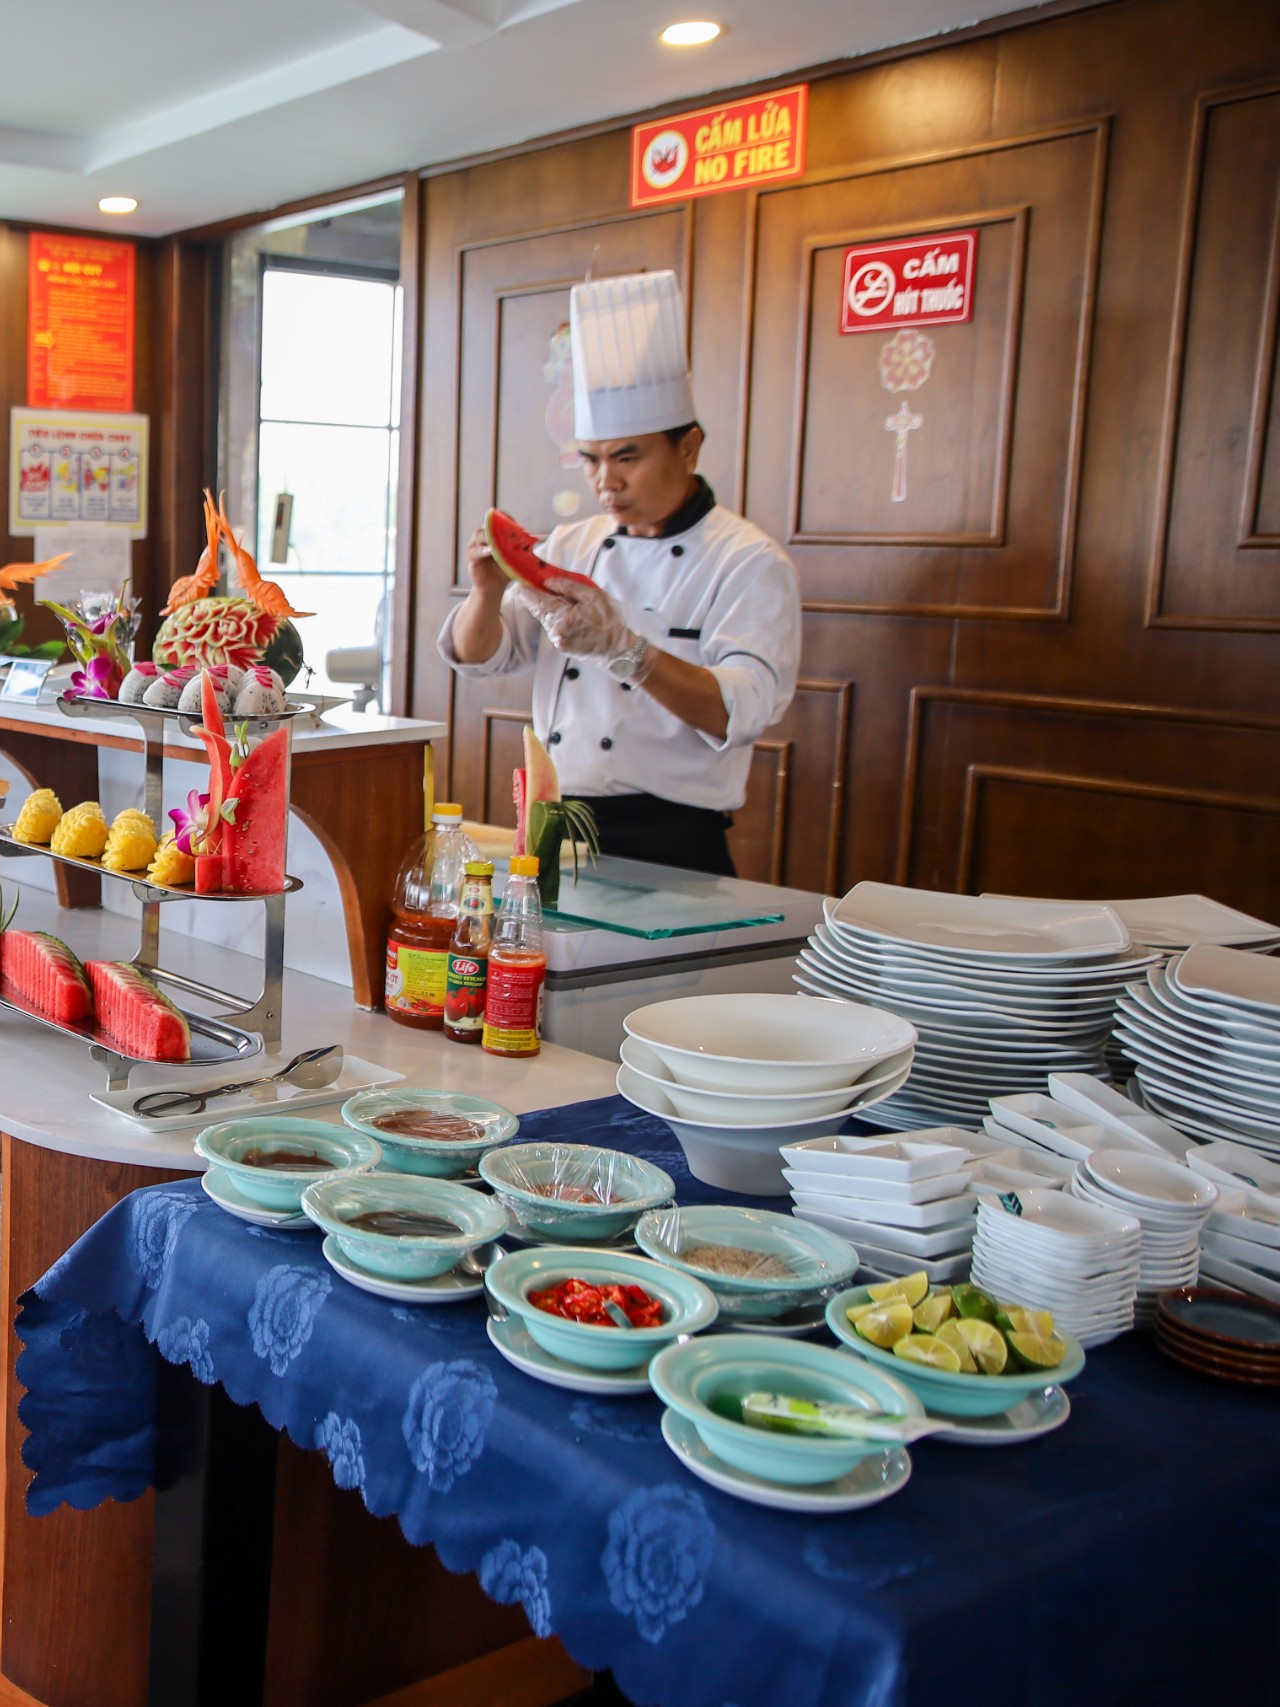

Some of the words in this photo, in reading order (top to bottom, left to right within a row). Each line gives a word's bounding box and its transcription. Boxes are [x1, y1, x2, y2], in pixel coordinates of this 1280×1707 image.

[695, 111, 743, 154] CẤM
[747, 100, 791, 141] LỬA
[694, 154, 728, 186] NO
[733, 140, 791, 178] FIRE
[903, 247, 959, 279] CẤM
[455, 961, 475, 975] Life
